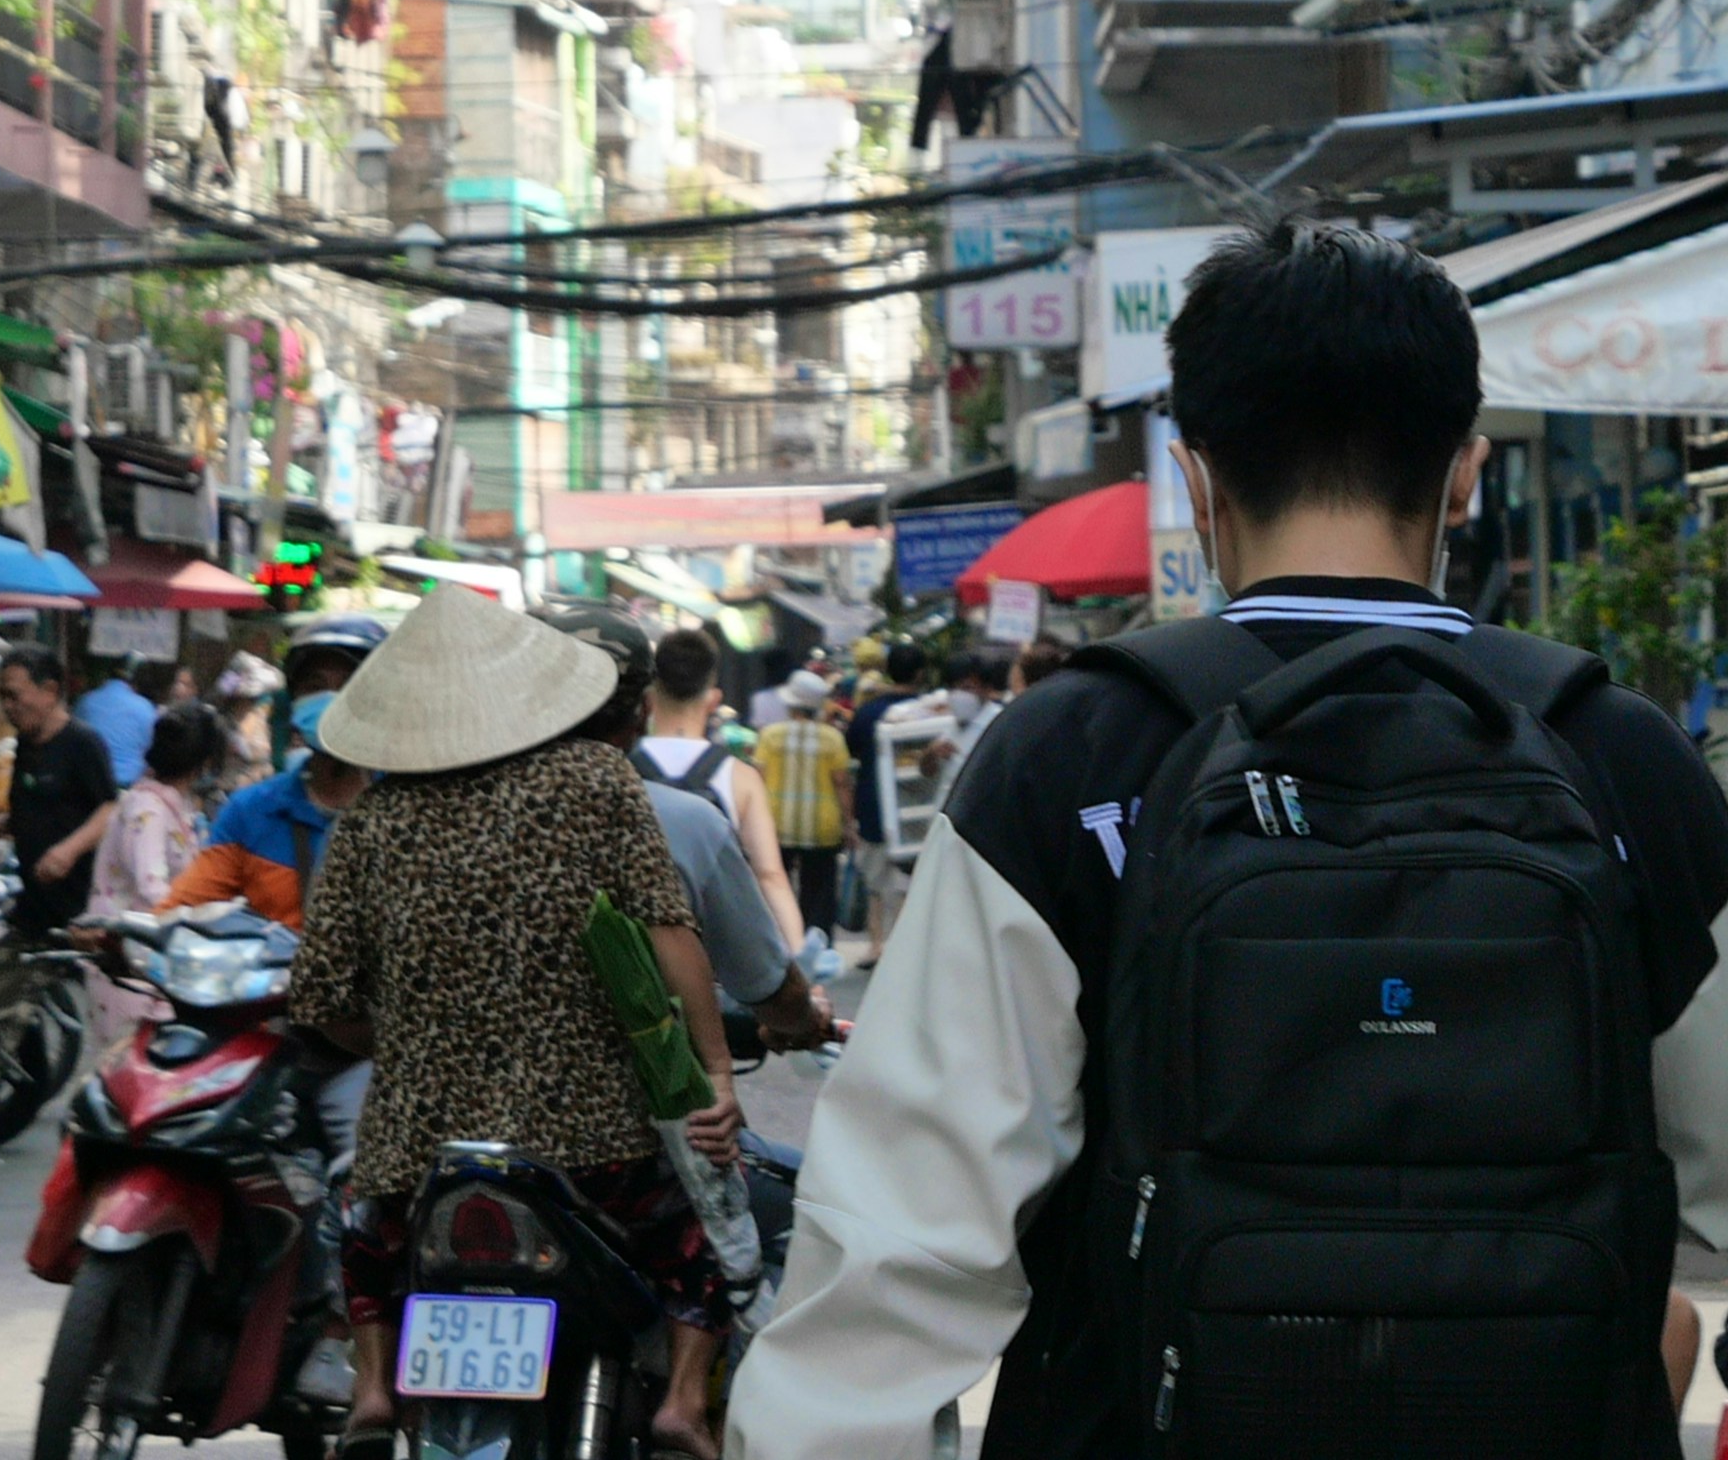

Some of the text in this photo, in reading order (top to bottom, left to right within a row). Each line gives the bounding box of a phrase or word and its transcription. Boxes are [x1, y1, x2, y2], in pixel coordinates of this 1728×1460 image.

[959, 292, 1064, 337] 115
[1113, 264, 1170, 334] NHÀ
[1534, 300, 1659, 372] CÔ
[428, 1305, 526, 1345] 59-L1
[409, 1348, 538, 1390] 916.69
